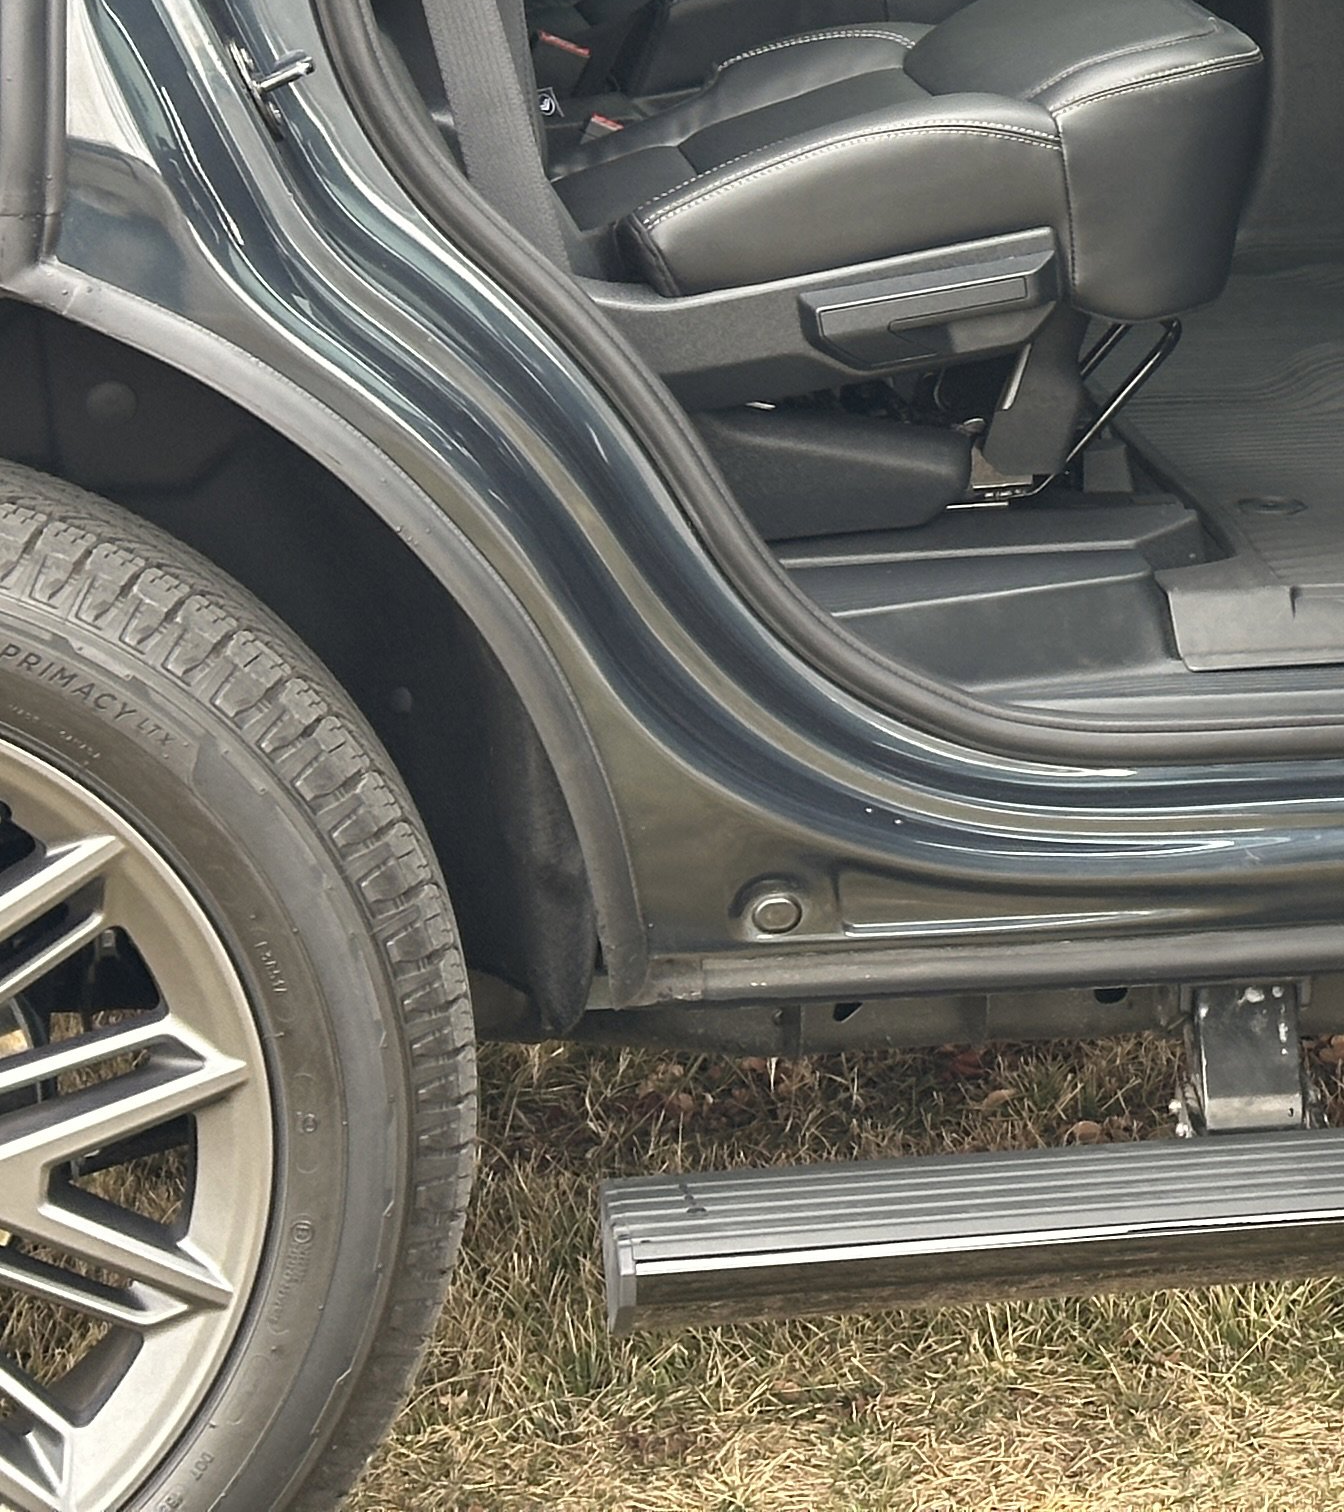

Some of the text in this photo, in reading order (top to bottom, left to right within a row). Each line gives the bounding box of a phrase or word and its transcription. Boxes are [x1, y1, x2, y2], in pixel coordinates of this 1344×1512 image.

[0, 643, 137, 721] PRIMACY
[136, 718, 174, 747] LTX
[189, 1451, 215, 1481] DOT
